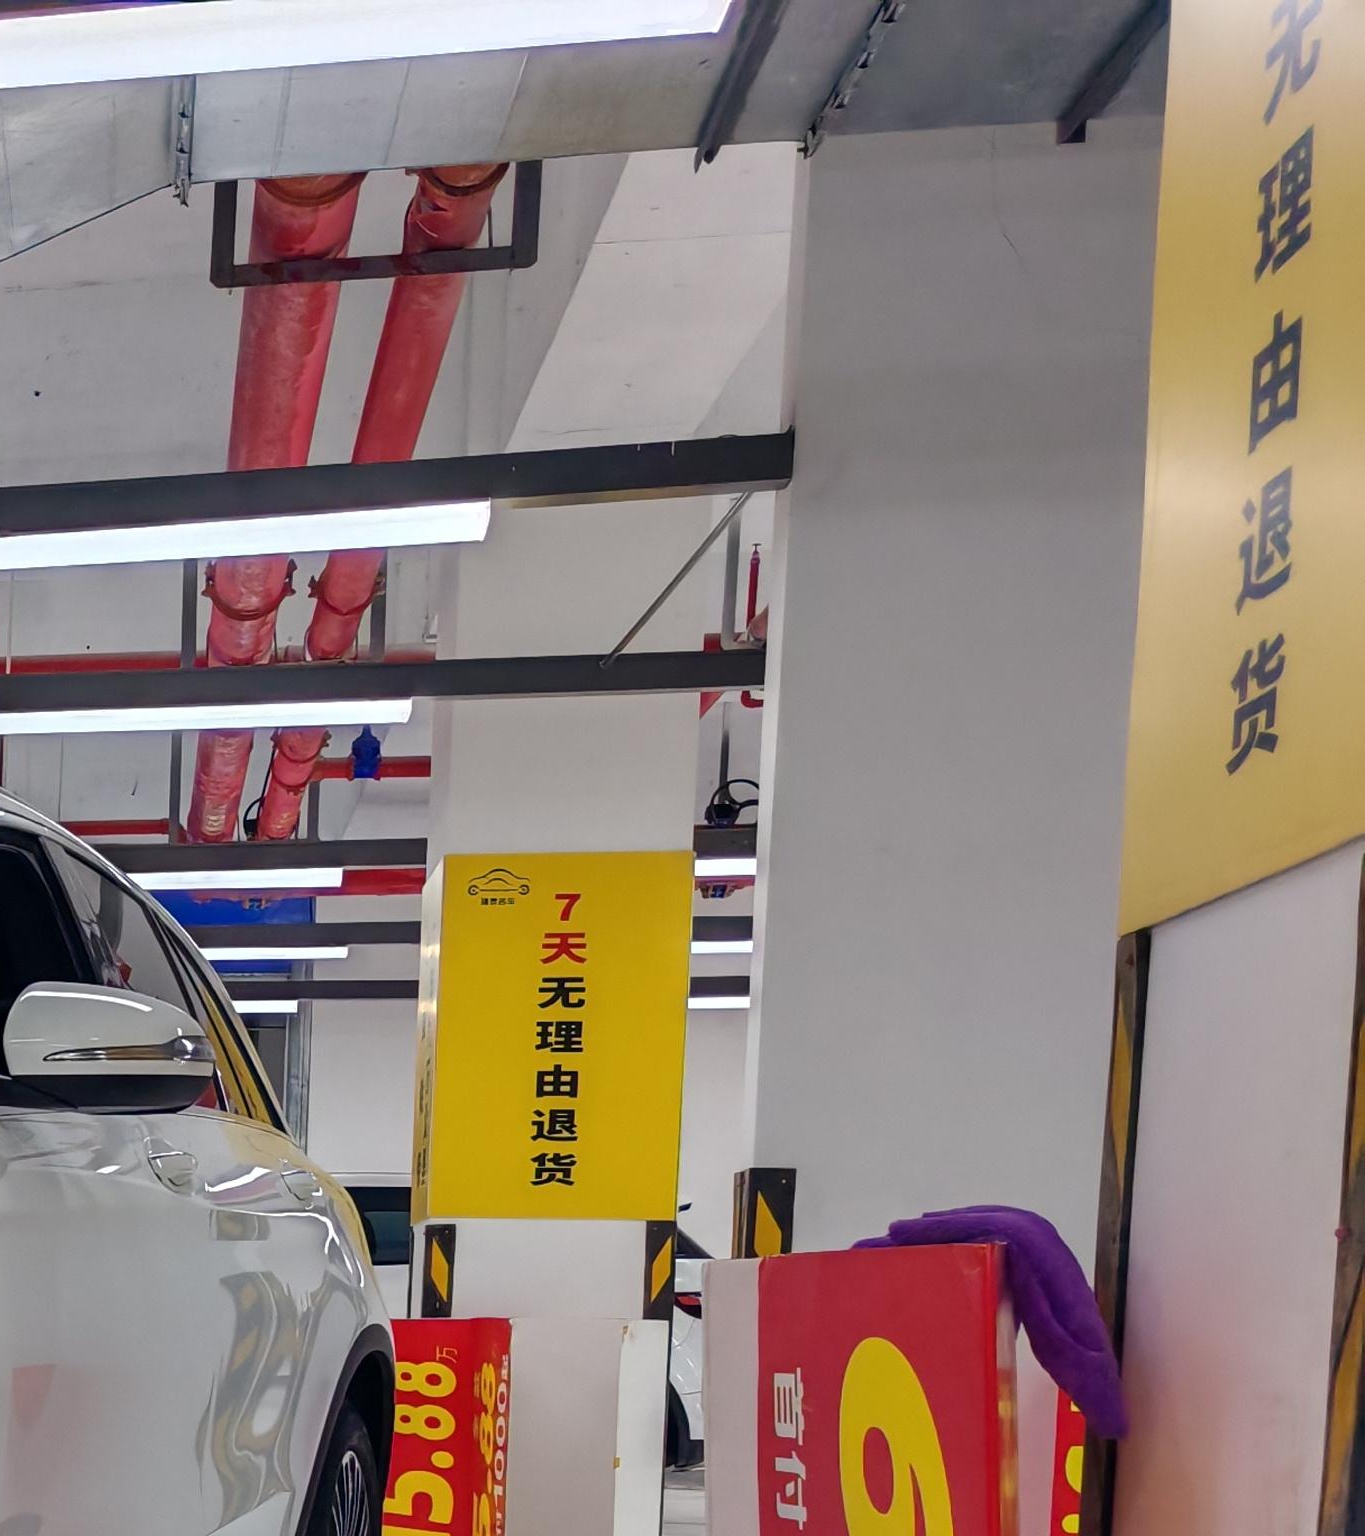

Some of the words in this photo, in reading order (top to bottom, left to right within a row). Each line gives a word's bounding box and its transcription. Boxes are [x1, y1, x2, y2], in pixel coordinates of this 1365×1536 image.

[530, 893, 588, 1187] 7天无理由退货
